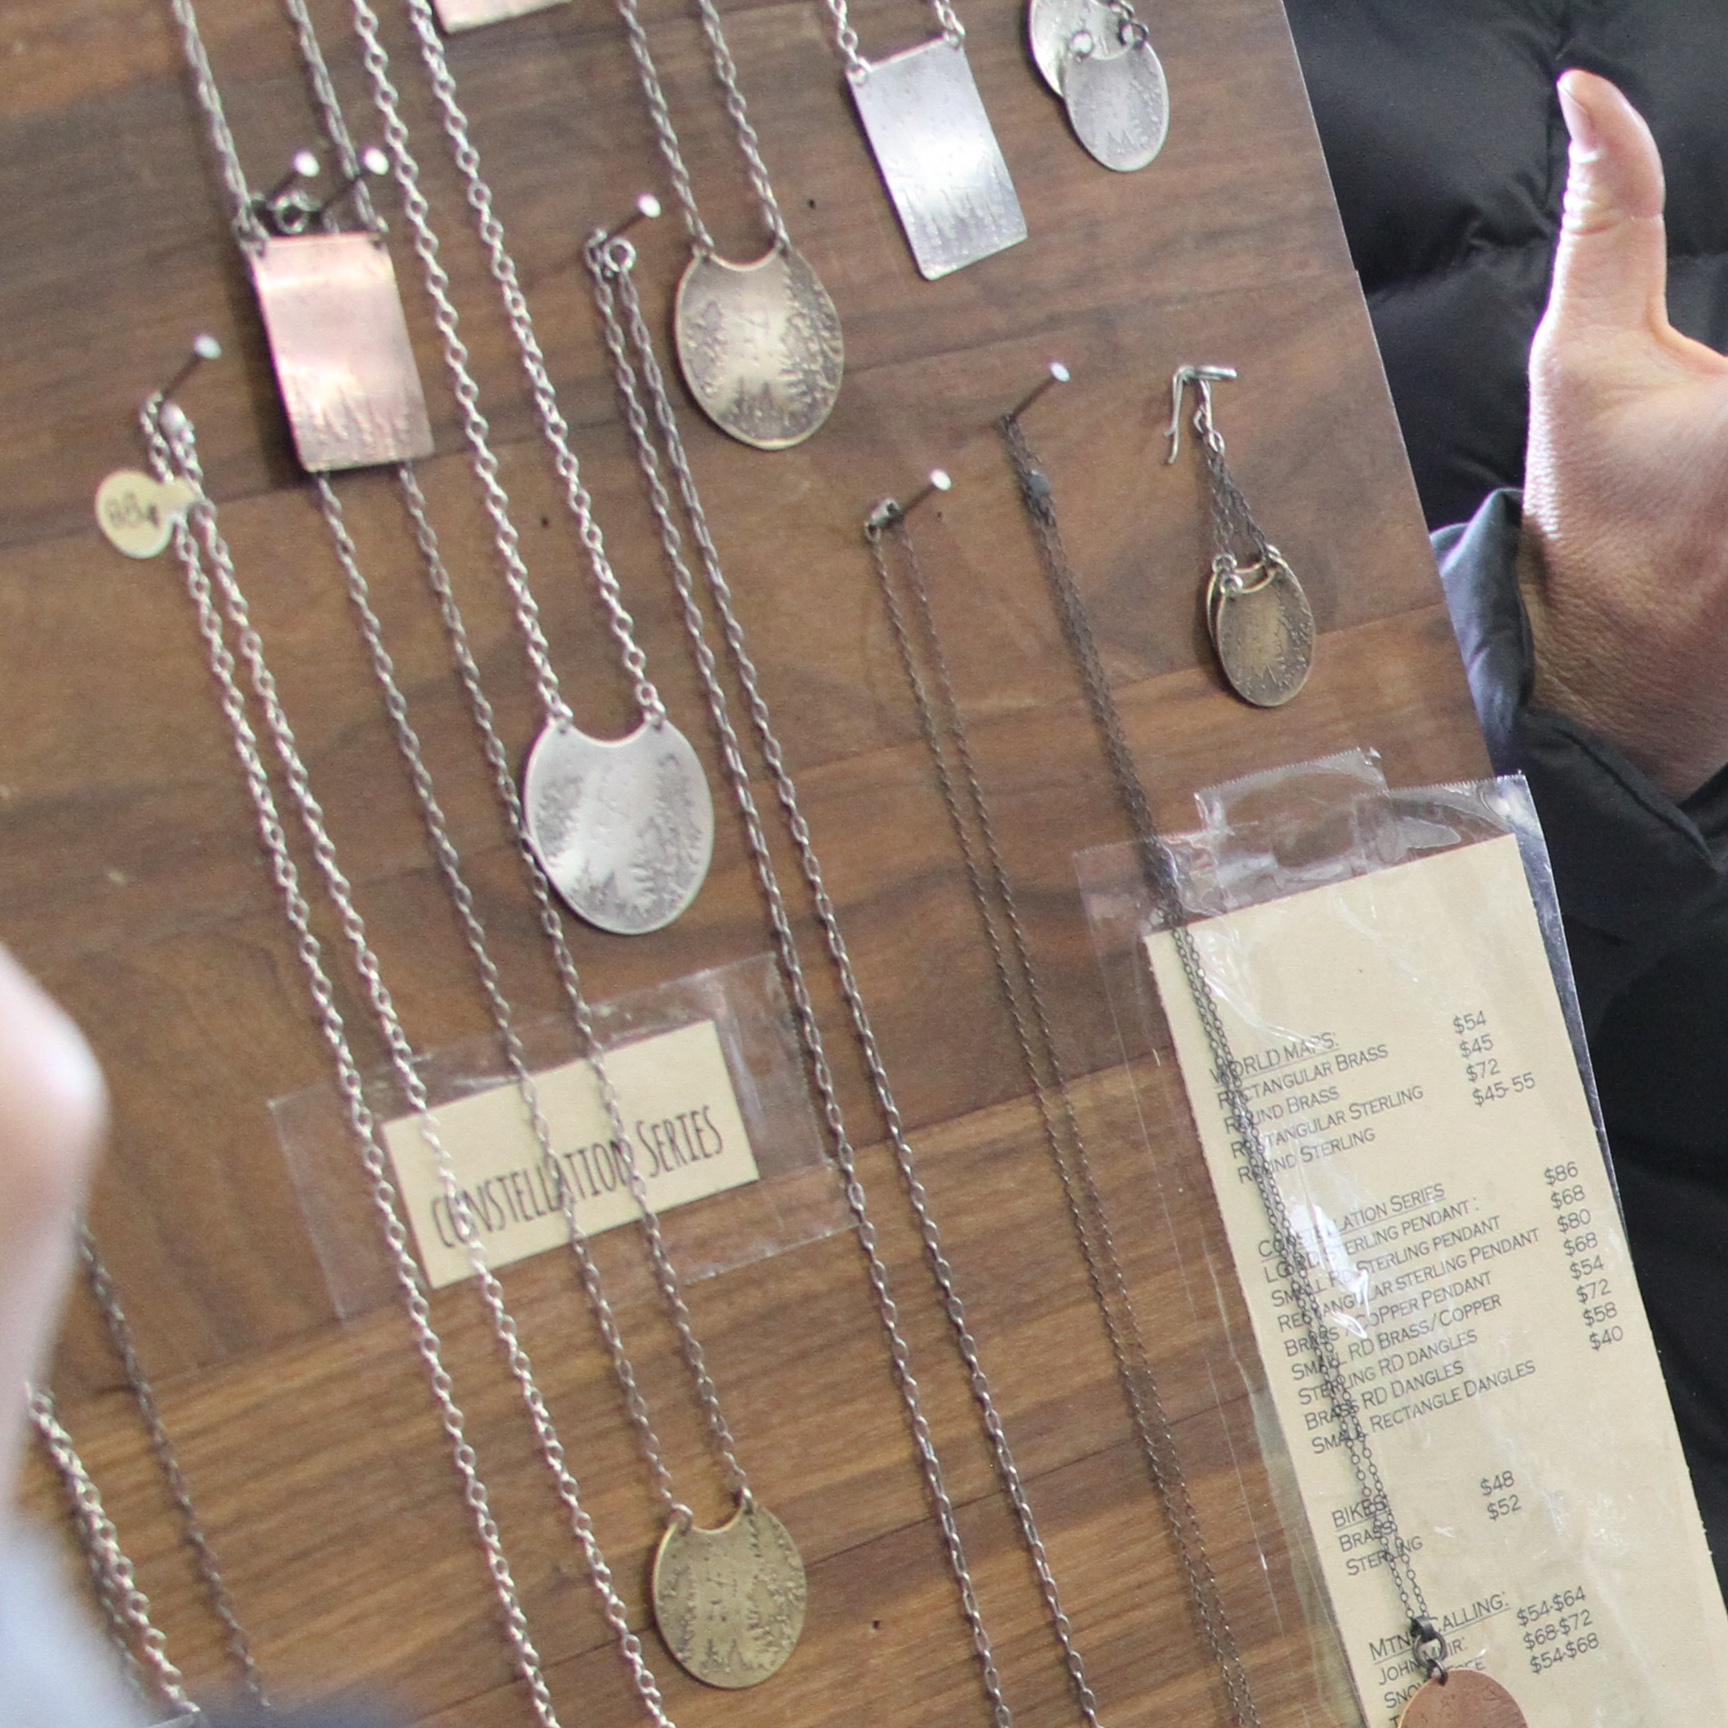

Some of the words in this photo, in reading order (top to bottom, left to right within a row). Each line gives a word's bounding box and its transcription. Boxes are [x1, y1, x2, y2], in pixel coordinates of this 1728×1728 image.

[1284, 1082, 1340, 1114] BRASS
[1457, 1031, 1494, 1059] $45
[1334, 1040, 1389, 1072] BRASS
[1450, 1007, 1487, 1036] $54
[633, 1096, 726, 1179] SERIES
[1229, 1107, 1347, 1159] RTANGULAR
[1347, 1082, 1425, 1121] STERLING
[1464, 1056, 1501, 1084] $72
[1237, 1150, 1298, 1184] RUND
[1298, 1124, 1377, 1164] STERLING
[1256, 1200, 1389, 1259] CSTELATION
[1388, 1180, 1446, 1213] SERIES
[1355, 1238, 1432, 1278] STERLING
[1431, 1214, 1502, 1251] PENDANT
[1548, 1182, 1586, 1211] $68
[1400, 1199, 1472, 1236] PENDANT
[1541, 1158, 1580, 1187] $86
[1277, 1278, 1394, 1332] REANGULAR
[1394, 1252, 1468, 1291] STERLING
[1468, 1226, 1541, 1265] PENDANT
[1554, 1206, 1593, 1235] $80
[1347, 1336, 1376, 1361] RD
[1376, 1291, 1502, 1350] BRASS/COPPER
[1568, 1252, 1606, 1282] $54
[1420, 1269, 1494, 1308] PENDANT
[1561, 1229, 1599, 1258] $68
[1304, 1395, 1361, 1431] BRASS
[1360, 1385, 1389, 1410] RD
[1389, 1357, 1465, 1399] DANGLES
[1581, 1299, 1619, 1329] $58
[1377, 1352, 1405, 1376] RD
[1405, 1327, 1479, 1366] DANGLES
[1574, 1276, 1612, 1306] $72
[1368, 1384, 1462, 1433] RECTANGLE
[1462, 1356, 1537, 1398] DANGLES
[1587, 1322, 1625, 1352] $40
[1338, 1517, 1394, 1553] BRASS
[1478, 1468, 1516, 1498] $48
[1485, 1492, 1523, 1522] $52
[1368, 1624, 1419, 1661] MTN
[1429, 1588, 1509, 1636] ALLING:
[1514, 1583, 1587, 1629] $54-$64
[1521, 1606, 1593, 1653] $68-$72
[1527, 1630, 1600, 1676] $54-$68
